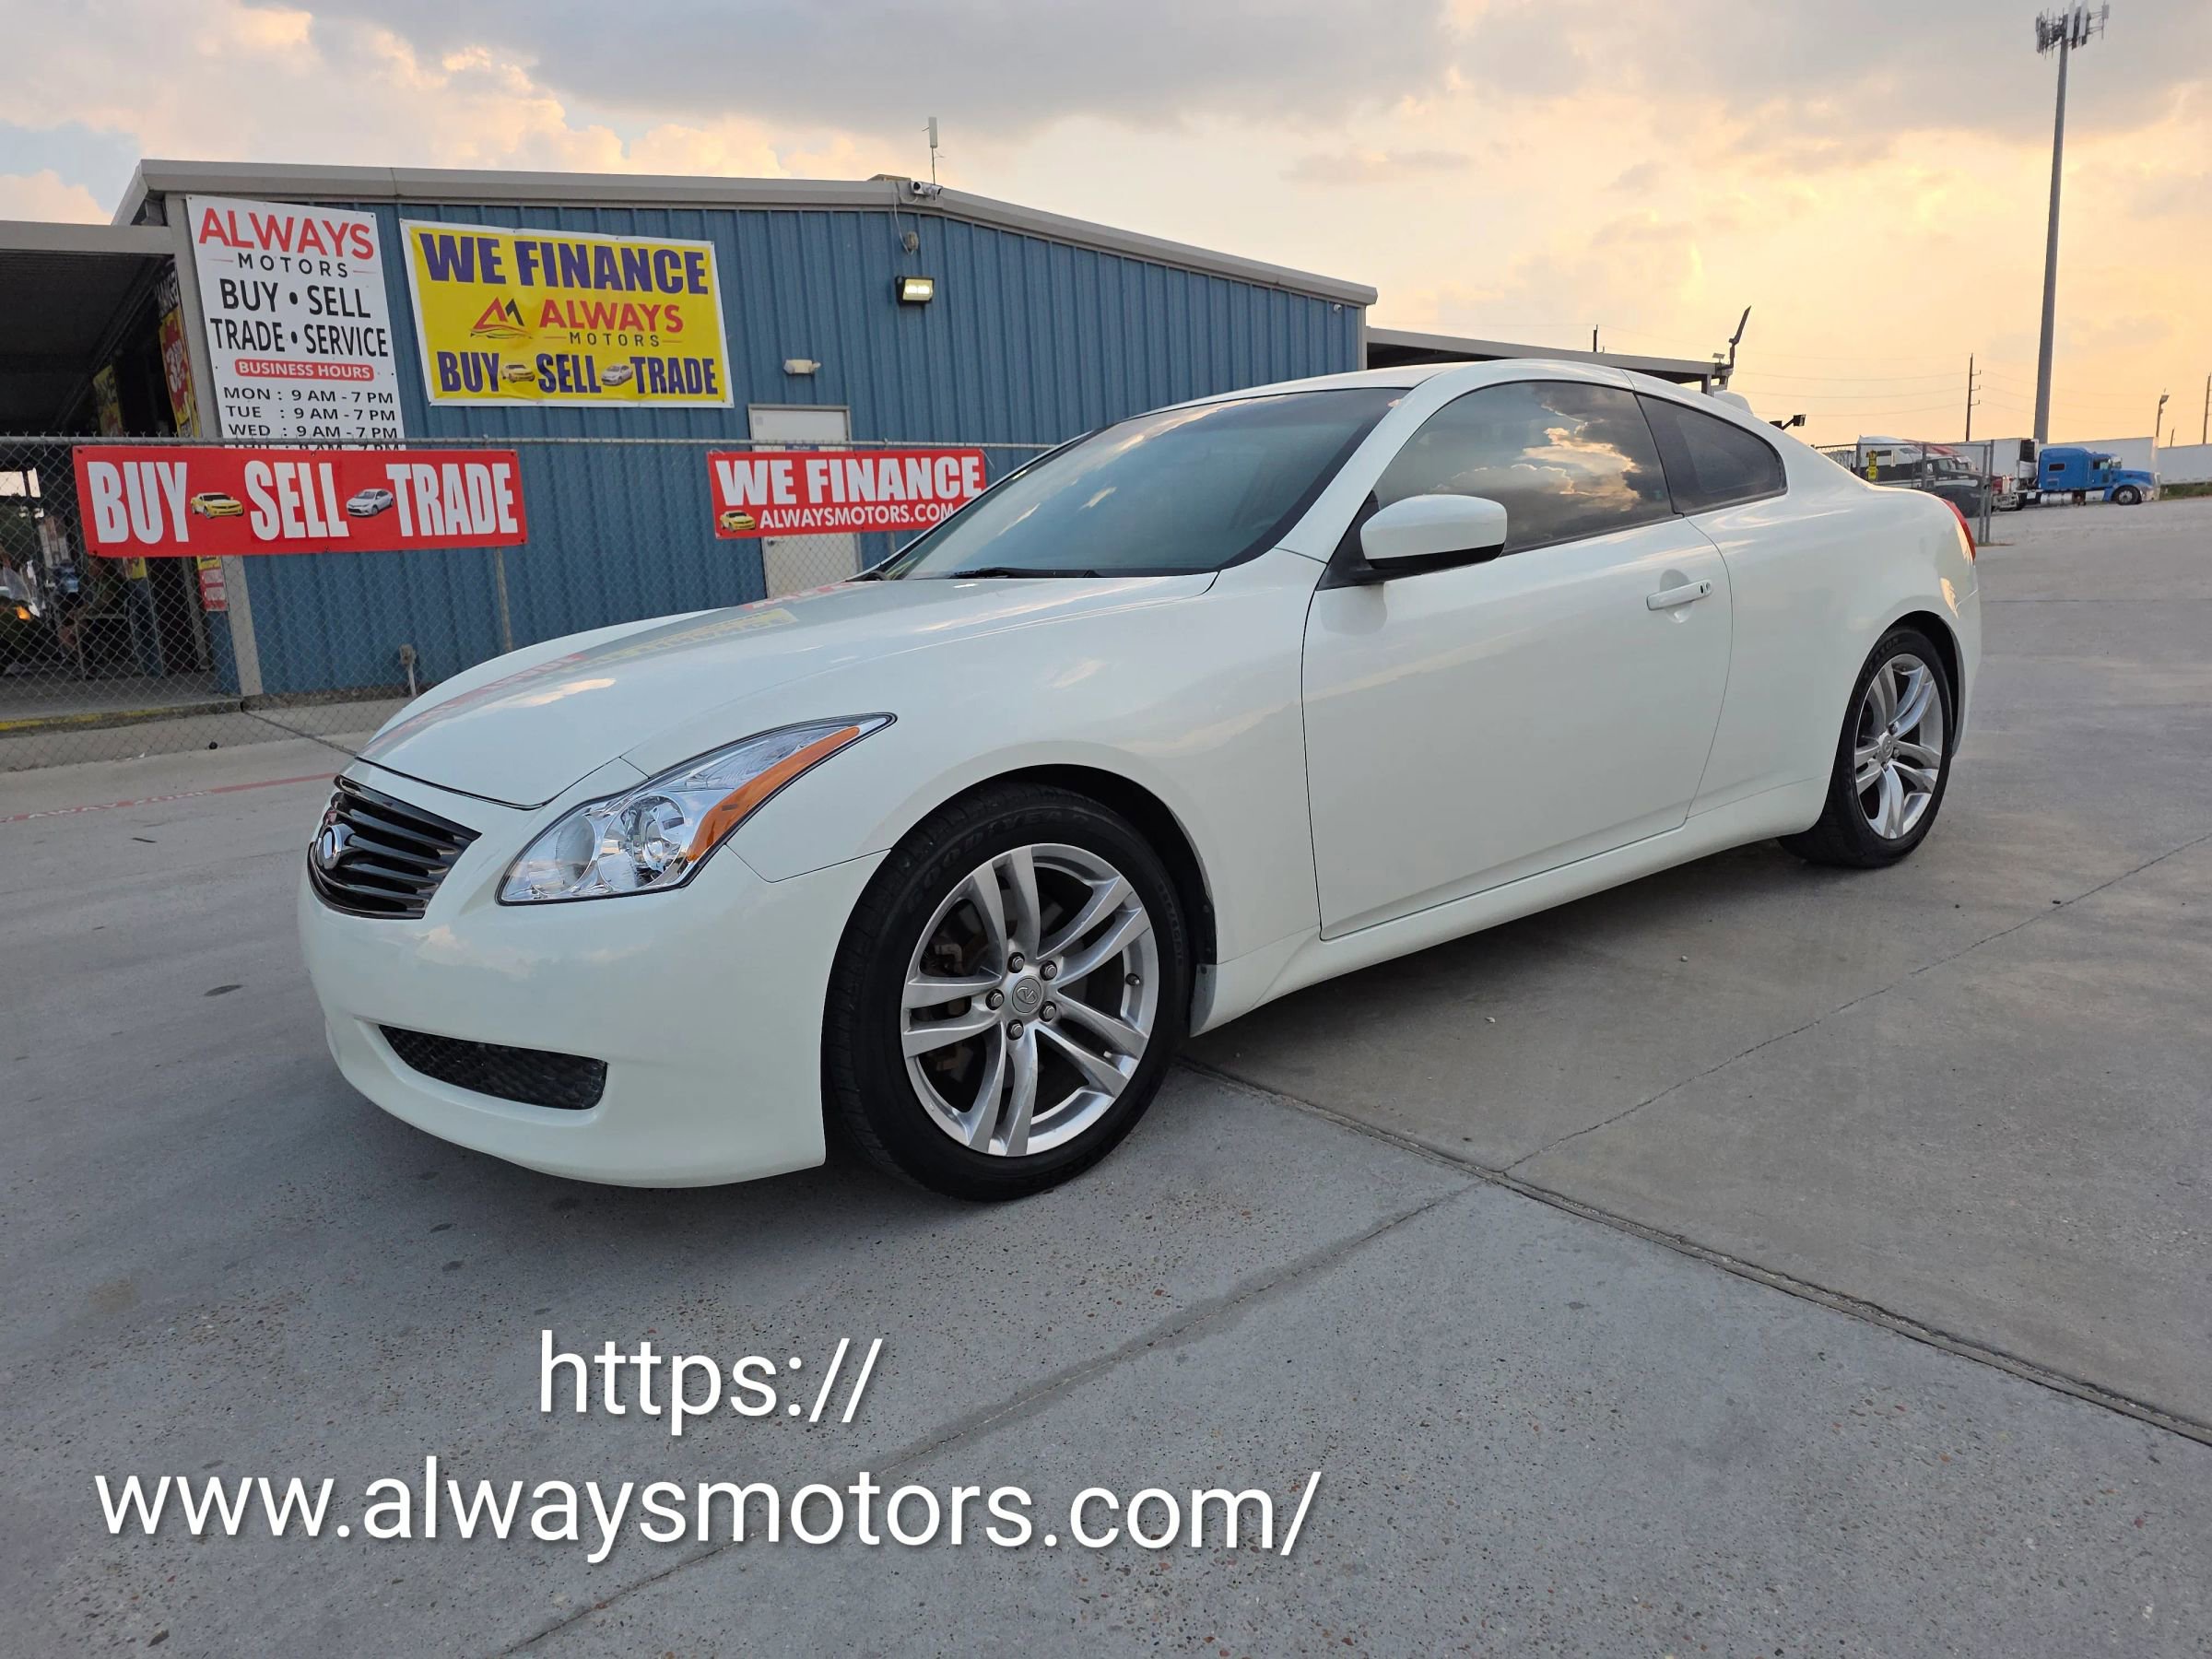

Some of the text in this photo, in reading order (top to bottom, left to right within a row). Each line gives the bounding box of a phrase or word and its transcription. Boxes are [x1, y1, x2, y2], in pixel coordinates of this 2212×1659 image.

[199, 208, 373, 259] ALWAYS
[238, 253, 347, 277] MOTORS
[421, 234, 709, 294] WE FINANCE
[220, 278, 277, 312] BUY
[308, 285, 371, 318] SELL
[539, 298, 683, 333] ALWAYS
[210, 318, 388, 357] TRADE SERVICE
[570, 332, 659, 347] MOTORS
[239, 362, 371, 377] BUSINESS HOURS
[439, 353, 716, 393] BUY SELL TRADE
[224, 387, 270, 400] MON
[292, 390, 301, 401] 9
[308, 391, 335, 402] AM
[351, 392, 360, 403] 7
[368, 393, 393, 404] PM
[226, 406, 261, 418] TUE
[294, 408, 304, 418] 9
[311, 408, 337, 419] AM
[354, 409, 362, 420] 7
[370, 410, 394, 420] PM
[229, 424, 270, 436] WED
[297, 426, 306, 437] 9
[312, 426, 340, 438] AM
[356, 427, 365, 438] 7
[371, 428, 397, 439] PM
[715, 456, 982, 506] WE FINANCE
[88, 461, 518, 544] BUY SELL TRADE
[760, 503, 954, 530] ALWAYSMOTORS.COM
